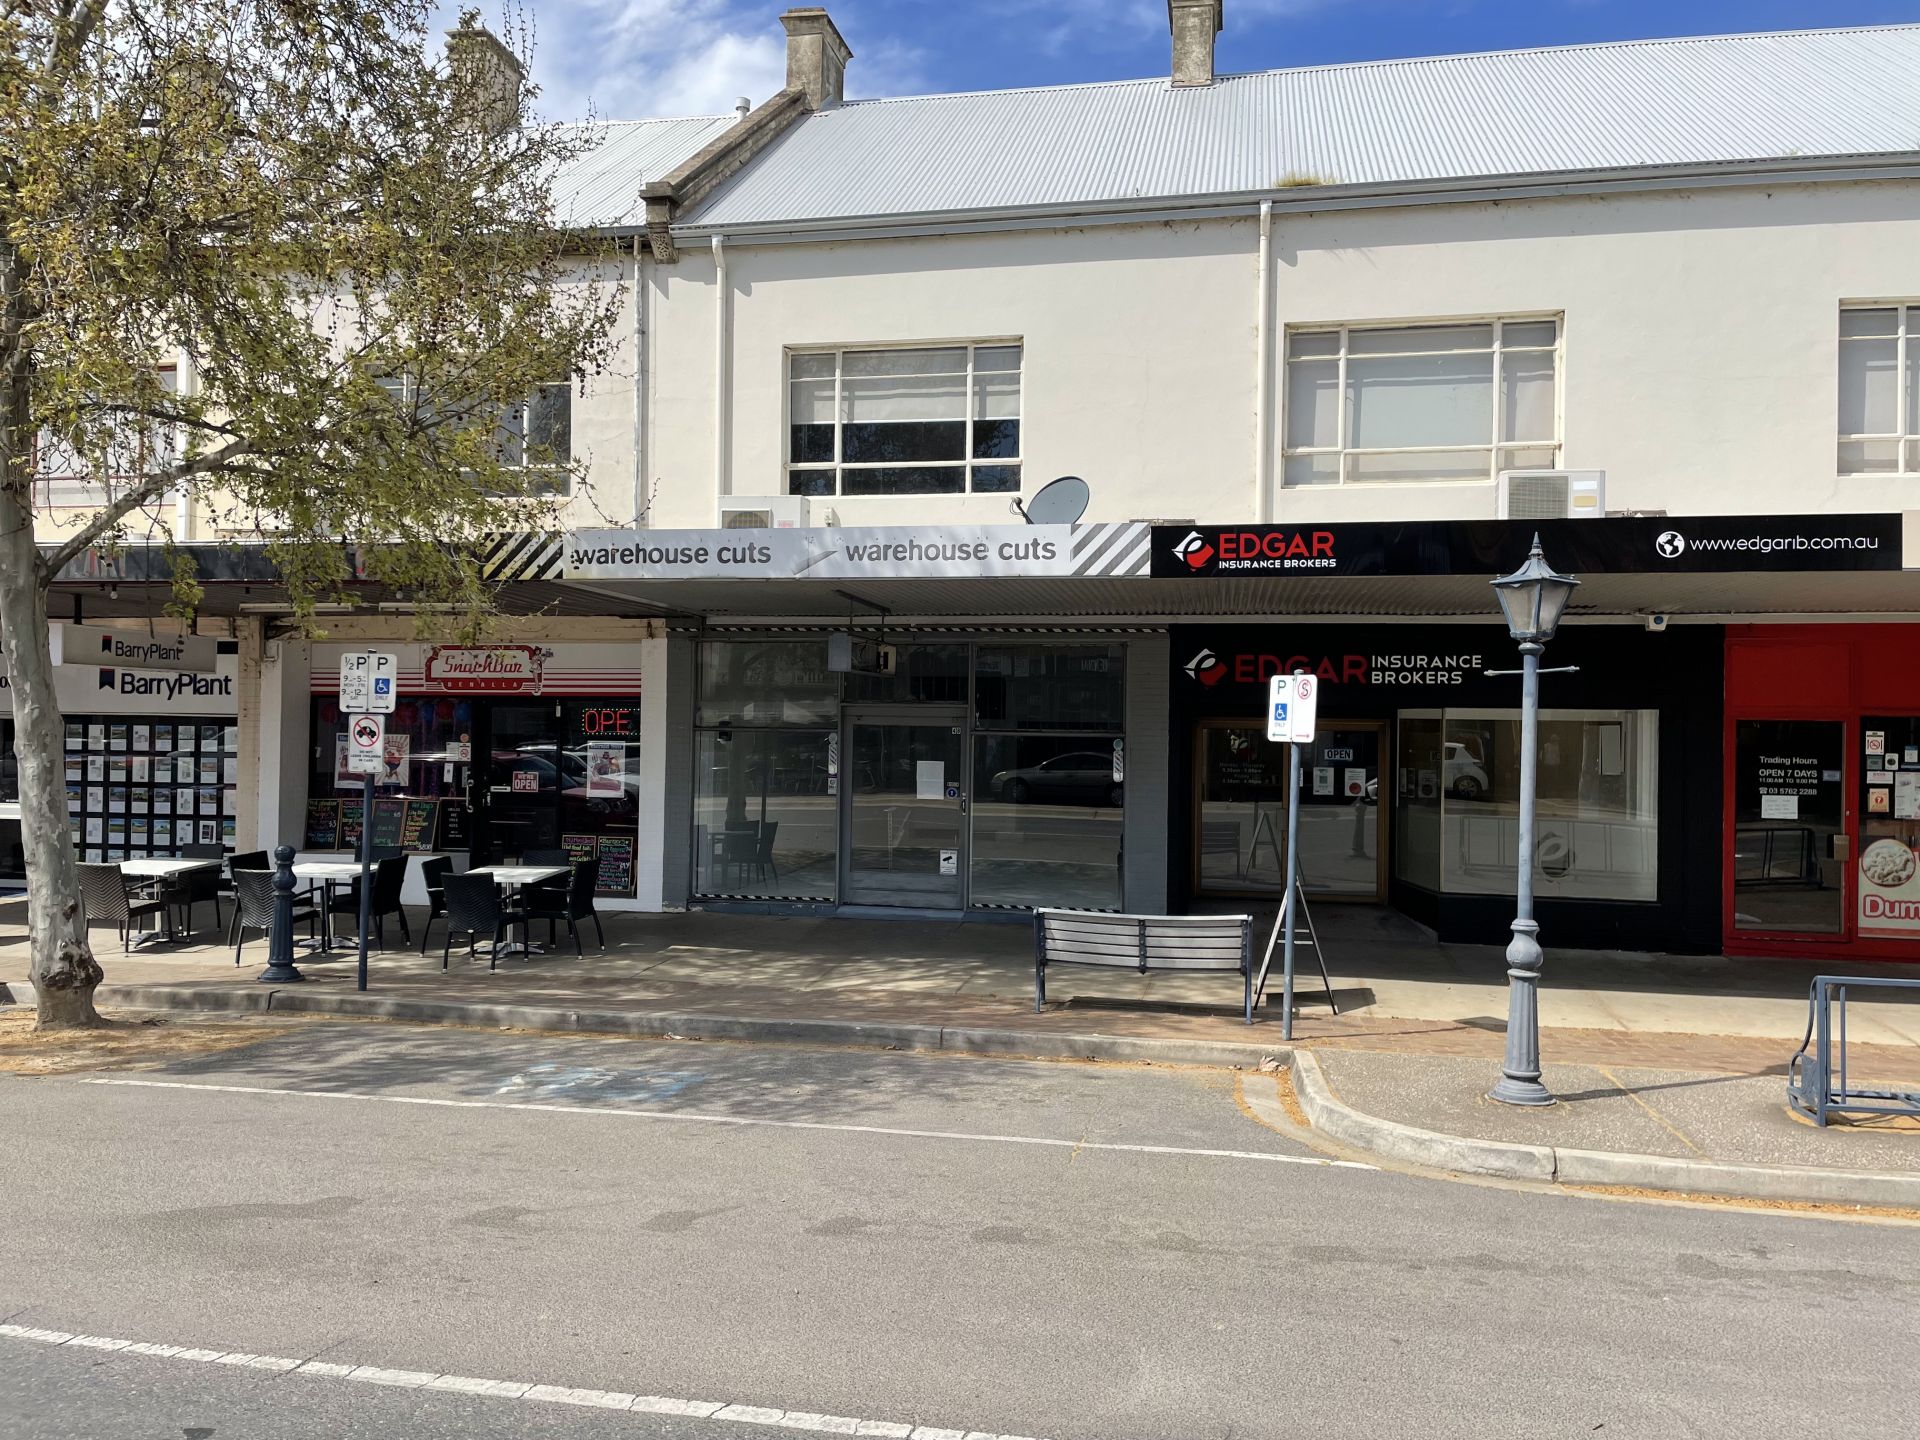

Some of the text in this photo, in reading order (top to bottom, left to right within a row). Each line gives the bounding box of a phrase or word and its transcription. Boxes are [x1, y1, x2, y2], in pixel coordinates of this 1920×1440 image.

[845, 537, 1057, 561] warehouse cuts
[1219, 531, 1335, 559] EDGAR
[1689, 535, 1878, 553] www.edgarib.com.au
[574, 542, 772, 565] warehouse cuts
[1218, 558, 1337, 569] INSURANCE BROKERS
[115, 640, 181, 662] BarryPlant
[377, 656, 389, 670] P
[1234, 654, 1369, 684] EDGAR
[1371, 655, 1482, 669] INSURANCE
[1371, 671, 1463, 685] BROKERS
[120, 673, 232, 700] BarryPlant
[1277, 680, 1287, 695] P
[1327, 750, 1351, 759] OPEN
[1759, 756, 1818, 765] Trading Hours
[1758, 769, 1818, 778] OPEN 7 DAYS
[514, 779, 537, 790] OPEN
